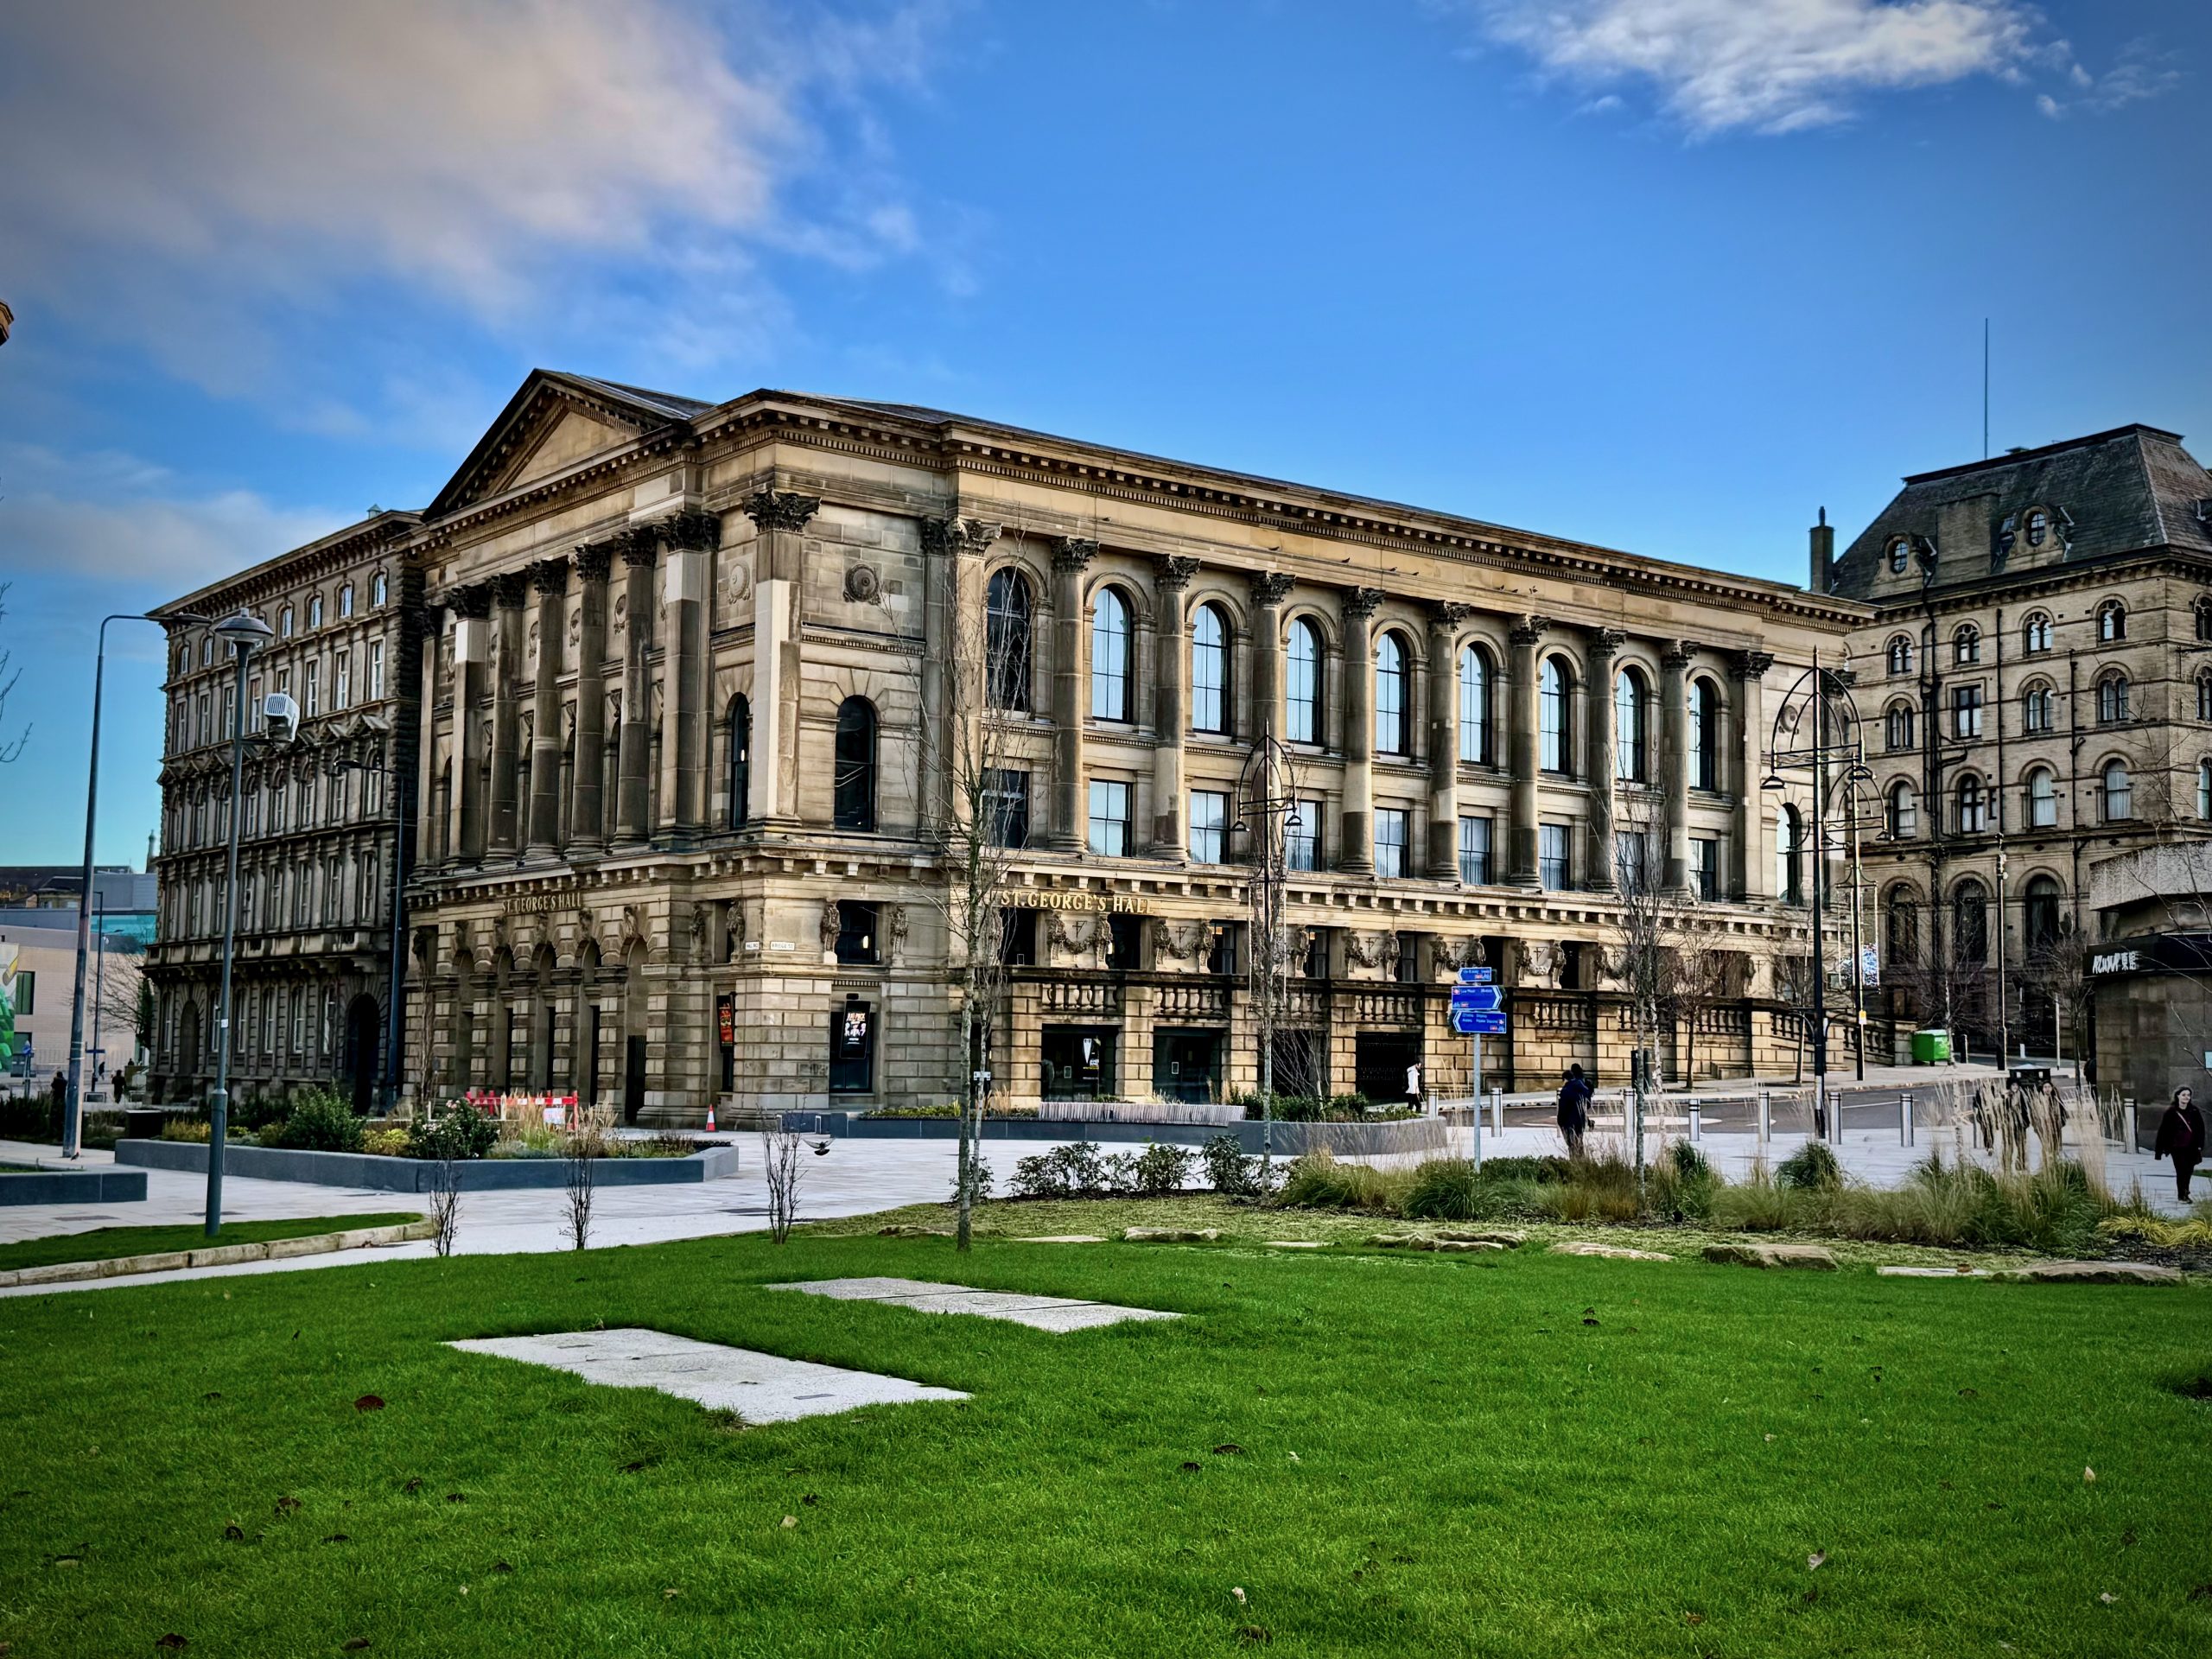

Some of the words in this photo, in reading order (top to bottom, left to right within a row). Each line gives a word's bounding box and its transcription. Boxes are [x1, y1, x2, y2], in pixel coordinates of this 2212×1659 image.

[515, 895, 556, 912] GEORGE'S
[558, 893, 582, 908] HALL
[1027, 892, 1107, 912] GEORGE'S
[1113, 896, 1154, 913] HALL
